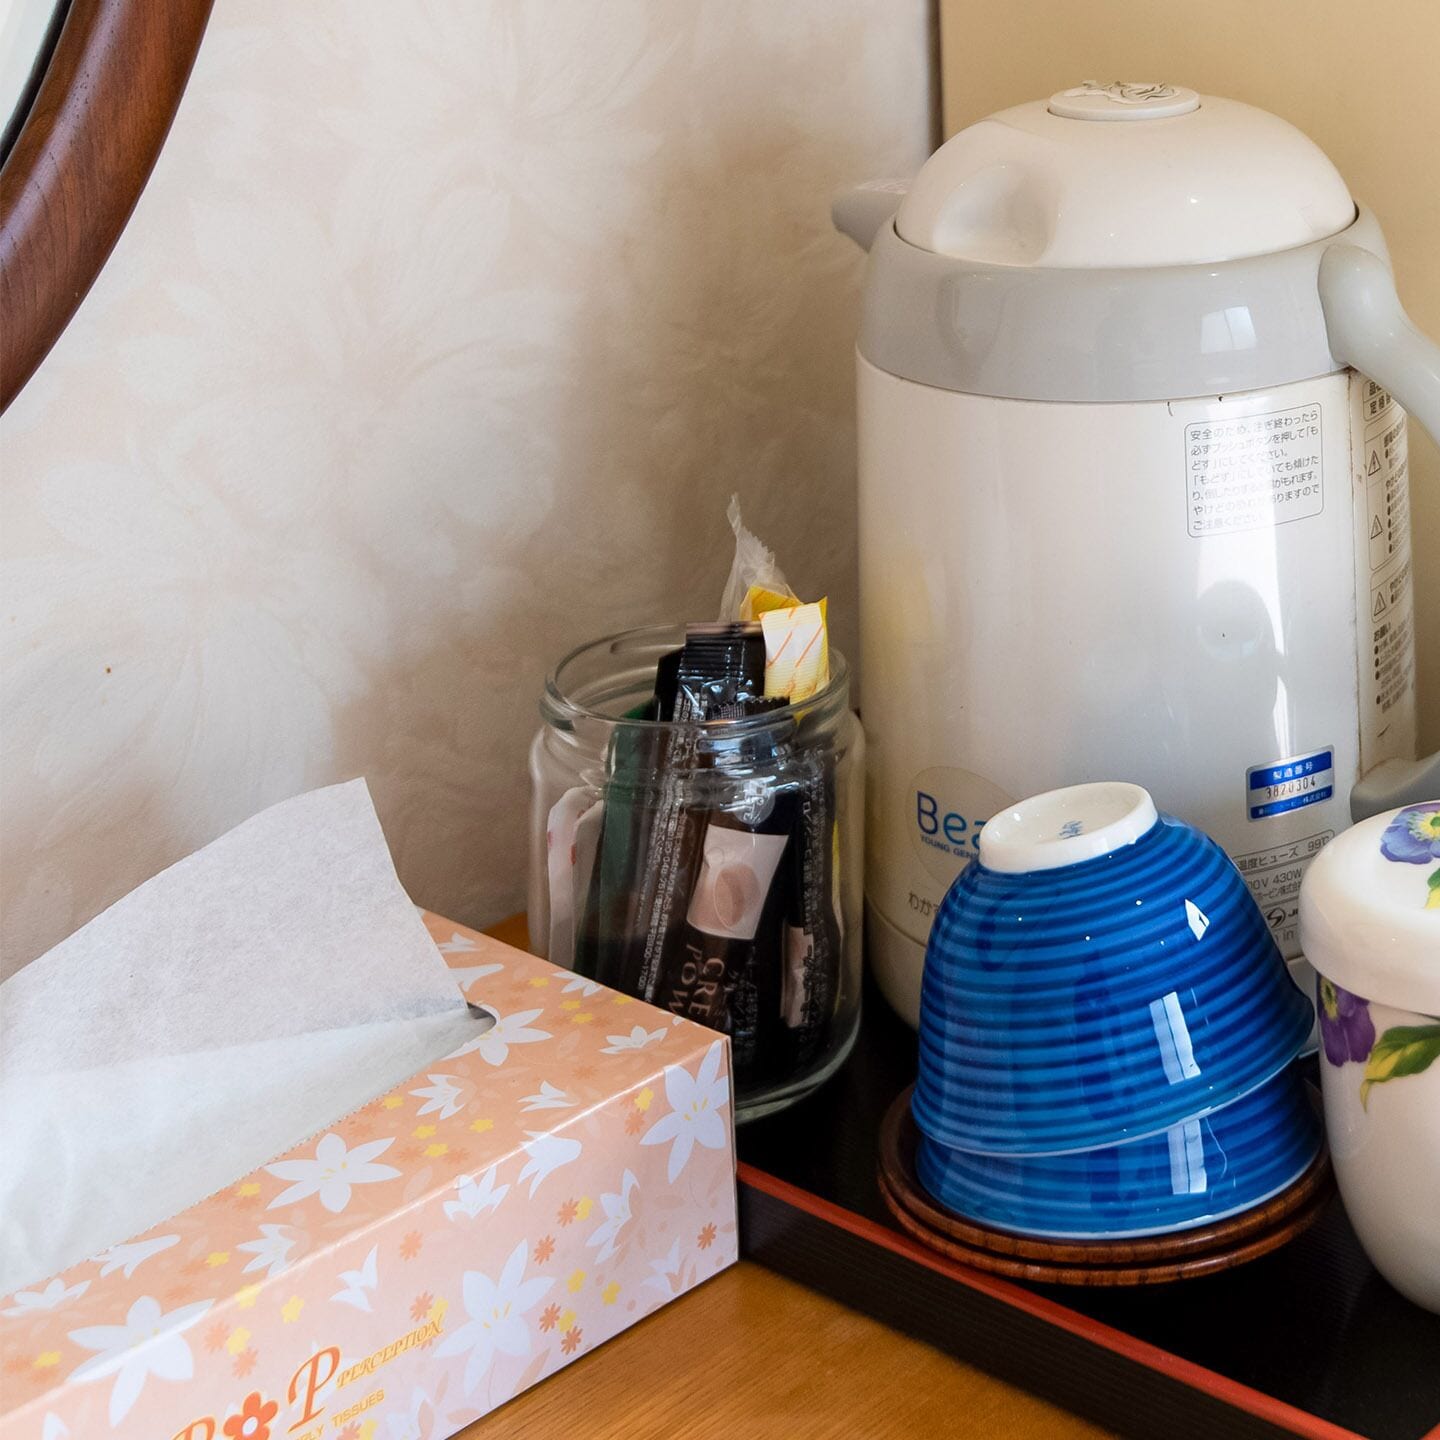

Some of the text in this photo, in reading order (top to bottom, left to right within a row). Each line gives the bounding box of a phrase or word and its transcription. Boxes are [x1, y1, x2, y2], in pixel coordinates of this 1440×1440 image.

[1272, 867, 1303, 884] 430W
[336, 1317, 445, 1390] PERCEPTION
[331, 1388, 385, 1428] TISSUES
